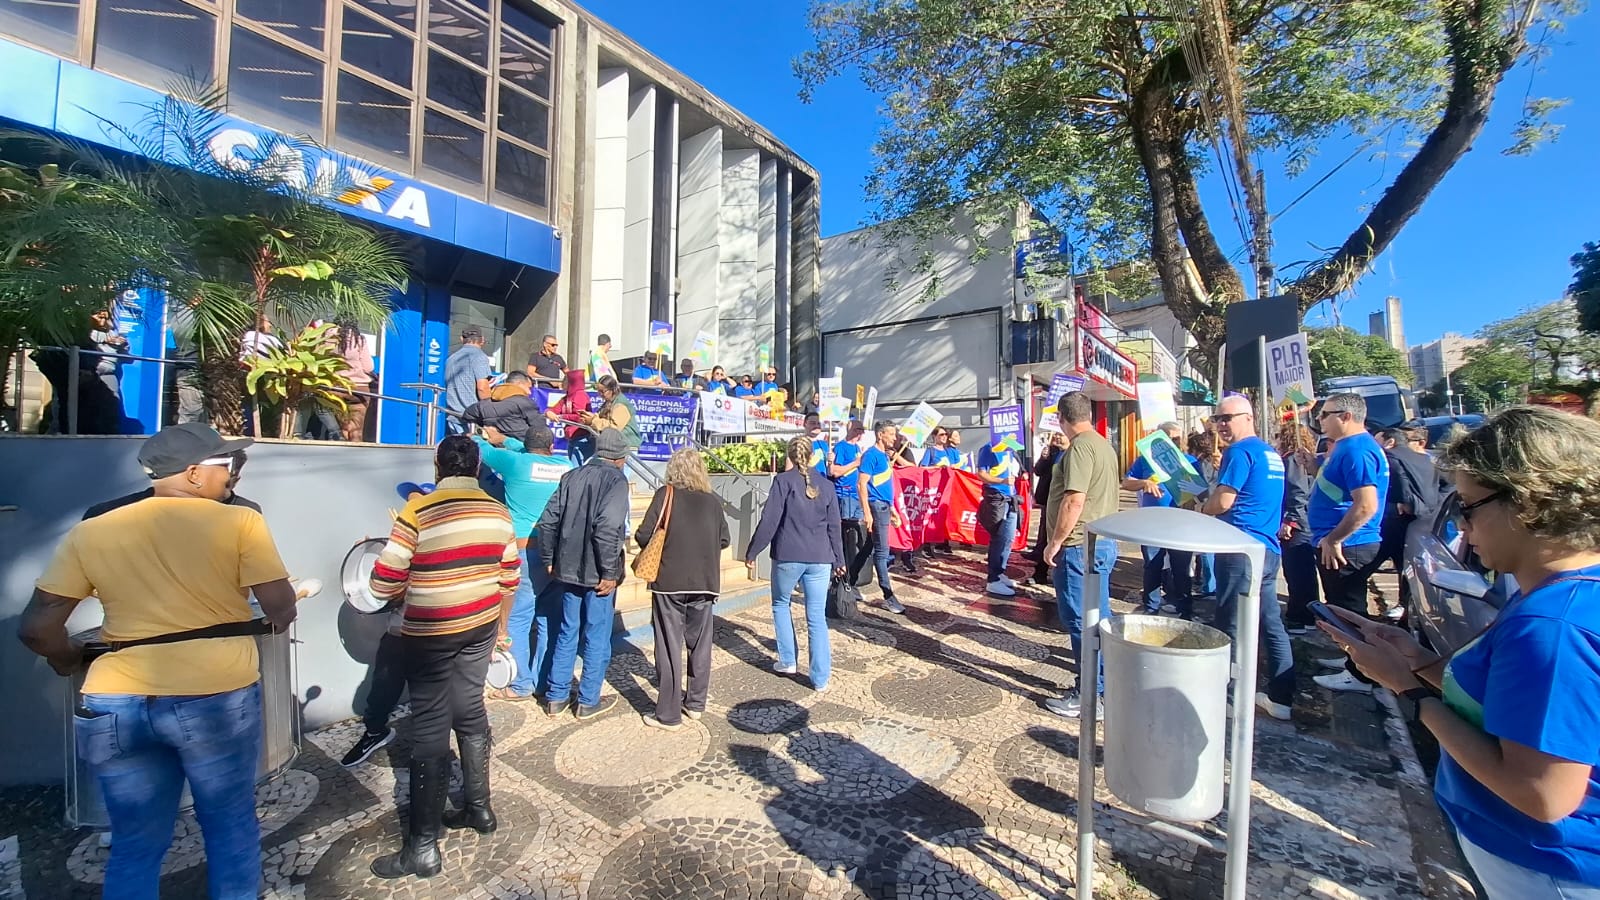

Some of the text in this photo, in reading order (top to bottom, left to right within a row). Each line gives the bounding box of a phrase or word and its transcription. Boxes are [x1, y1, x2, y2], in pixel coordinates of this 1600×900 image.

[1271, 341, 1303, 371] PLR
[1275, 366, 1305, 385] MAIOR
[635, 415, 690, 426] ANCÁRIOS
[992, 411, 1019, 427] MAIS
